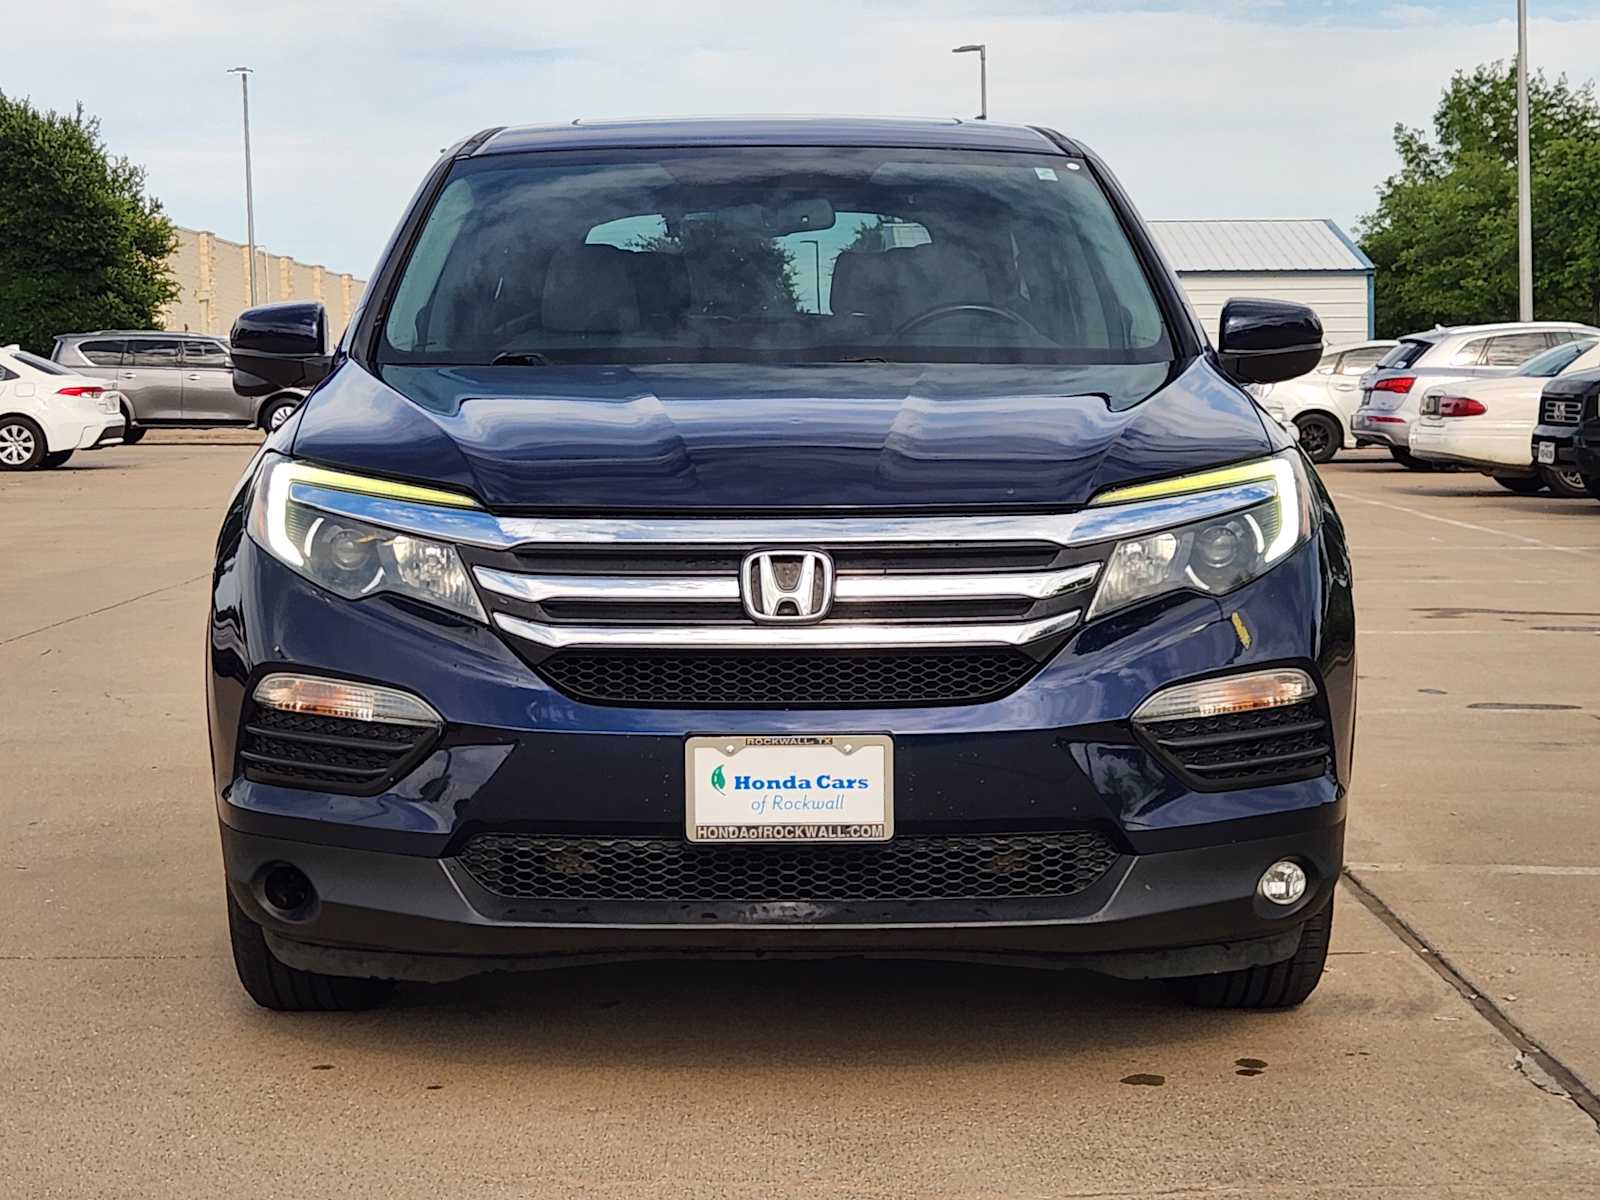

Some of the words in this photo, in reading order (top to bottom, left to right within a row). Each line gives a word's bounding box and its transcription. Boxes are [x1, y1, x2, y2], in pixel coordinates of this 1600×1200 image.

[818, 737, 832, 746] TX
[734, 775, 812, 790] Honda
[816, 775, 869, 790] Cars
[751, 795, 769, 815] of
[772, 794, 845, 810] Rockwall
